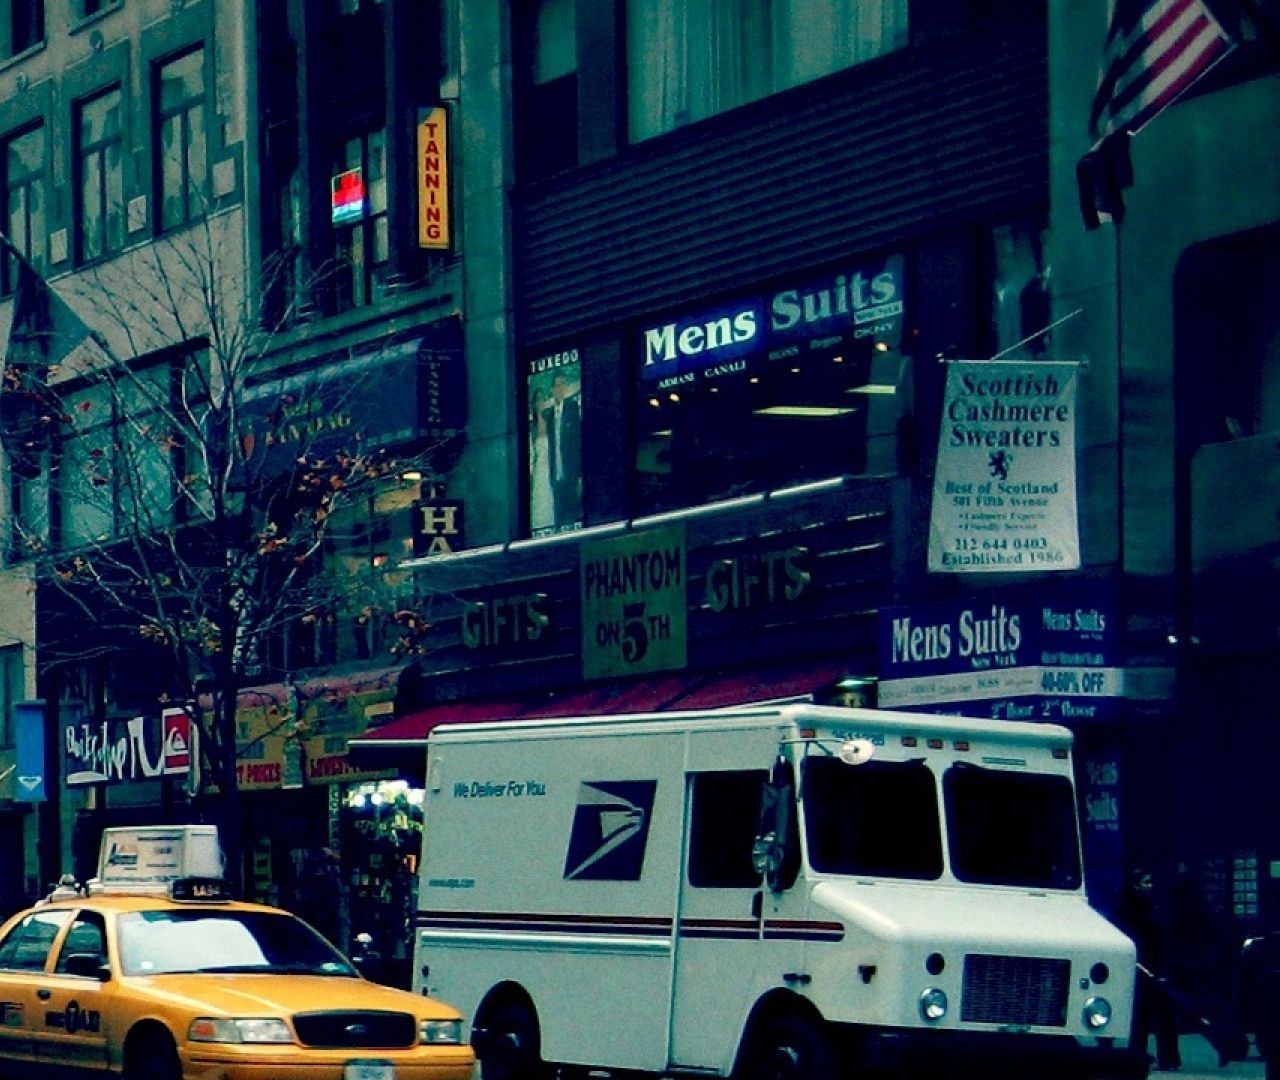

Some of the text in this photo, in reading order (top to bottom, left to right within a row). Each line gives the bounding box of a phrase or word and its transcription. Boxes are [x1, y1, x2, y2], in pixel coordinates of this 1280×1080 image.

[424, 122, 441, 240] TANNING
[644, 271, 895, 367] Mens Suits
[530, 349, 579, 373] TUXEDO
[704, 360, 747, 379] CANALI
[961, 373, 1059, 397] Scottish
[948, 399, 1068, 422] Cashmere
[949, 424, 1060, 447] Sweaters
[945, 481, 1059, 495] Best of Scotland
[955, 537, 1048, 550] 212 644 0403
[942, 552, 1023, 566] Established
[584, 547, 682, 600] PHANTOM
[704, 546, 813, 612] GIFTS
[462, 592, 551, 650] GIFTS
[1042, 607, 1072, 631] Mens
[1075, 608, 1106, 632] Suits
[596, 601, 670, 664] ON 5TH
[892, 604, 1021, 664] Mens Suits
[1082, 672, 1104, 693] OFF
[1061, 700, 1097, 718] floor
[454, 783, 468, 798] We
[470, 782, 506, 797] Deliver
[507, 781, 524, 796] For
